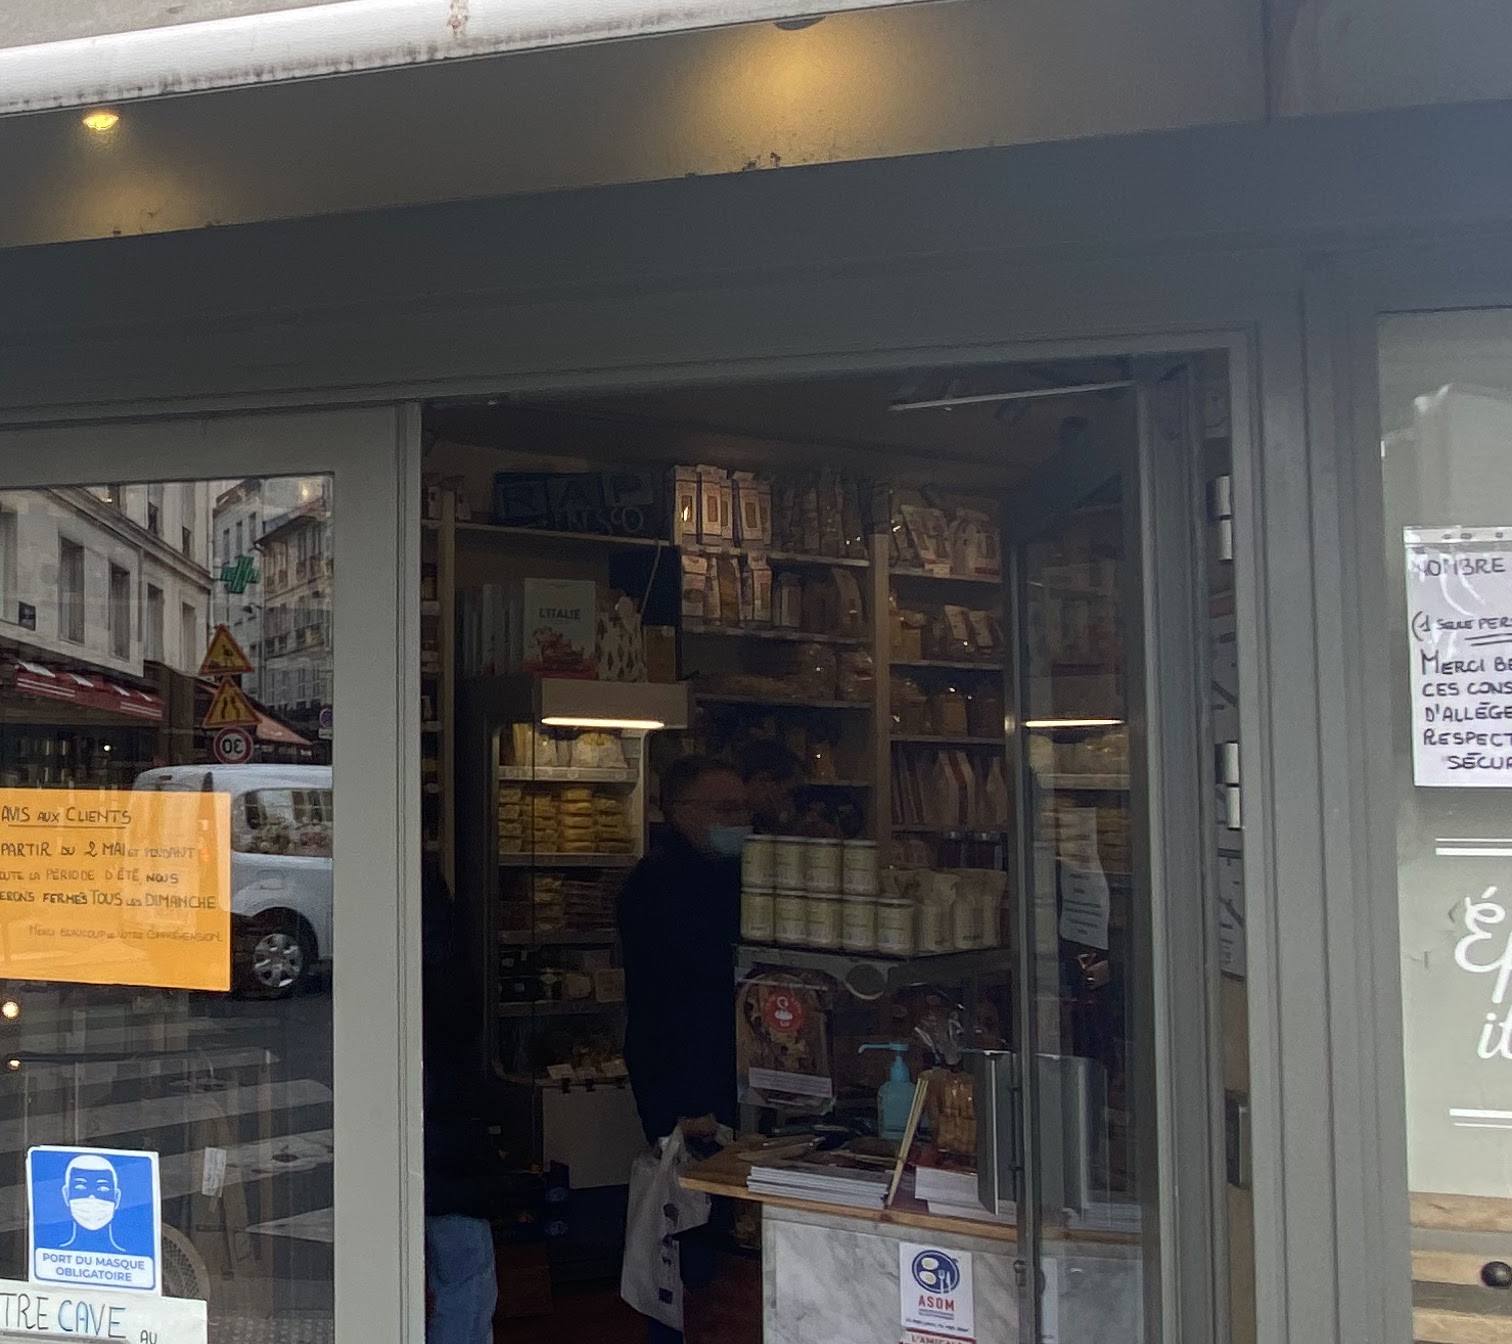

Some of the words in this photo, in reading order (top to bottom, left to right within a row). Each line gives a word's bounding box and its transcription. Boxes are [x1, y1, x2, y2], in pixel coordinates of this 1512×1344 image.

[1421, 649, 1485, 675] MERCI
[1422, 682, 1459, 696] CES
[2, 805, 30, 822] AVIS
[66, 806, 131, 824] CLIENTS
[1, 842, 52, 857] PARTIR
[84, 841, 97, 857] 2
[102, 841, 125, 857] MAI
[146, 873, 179, 884] NOUS
[90, 889, 123, 906] TOUS
[42, 1252, 72, 1266] PORT
[76, 1255, 92, 1267] DU
[95, 1256, 145, 1271] MASQUE
[55, 1266, 132, 1282] OBLIGATOIRE
[918, 1294, 955, 1312] ASOM
[58, 1300, 127, 1339] CAVE
